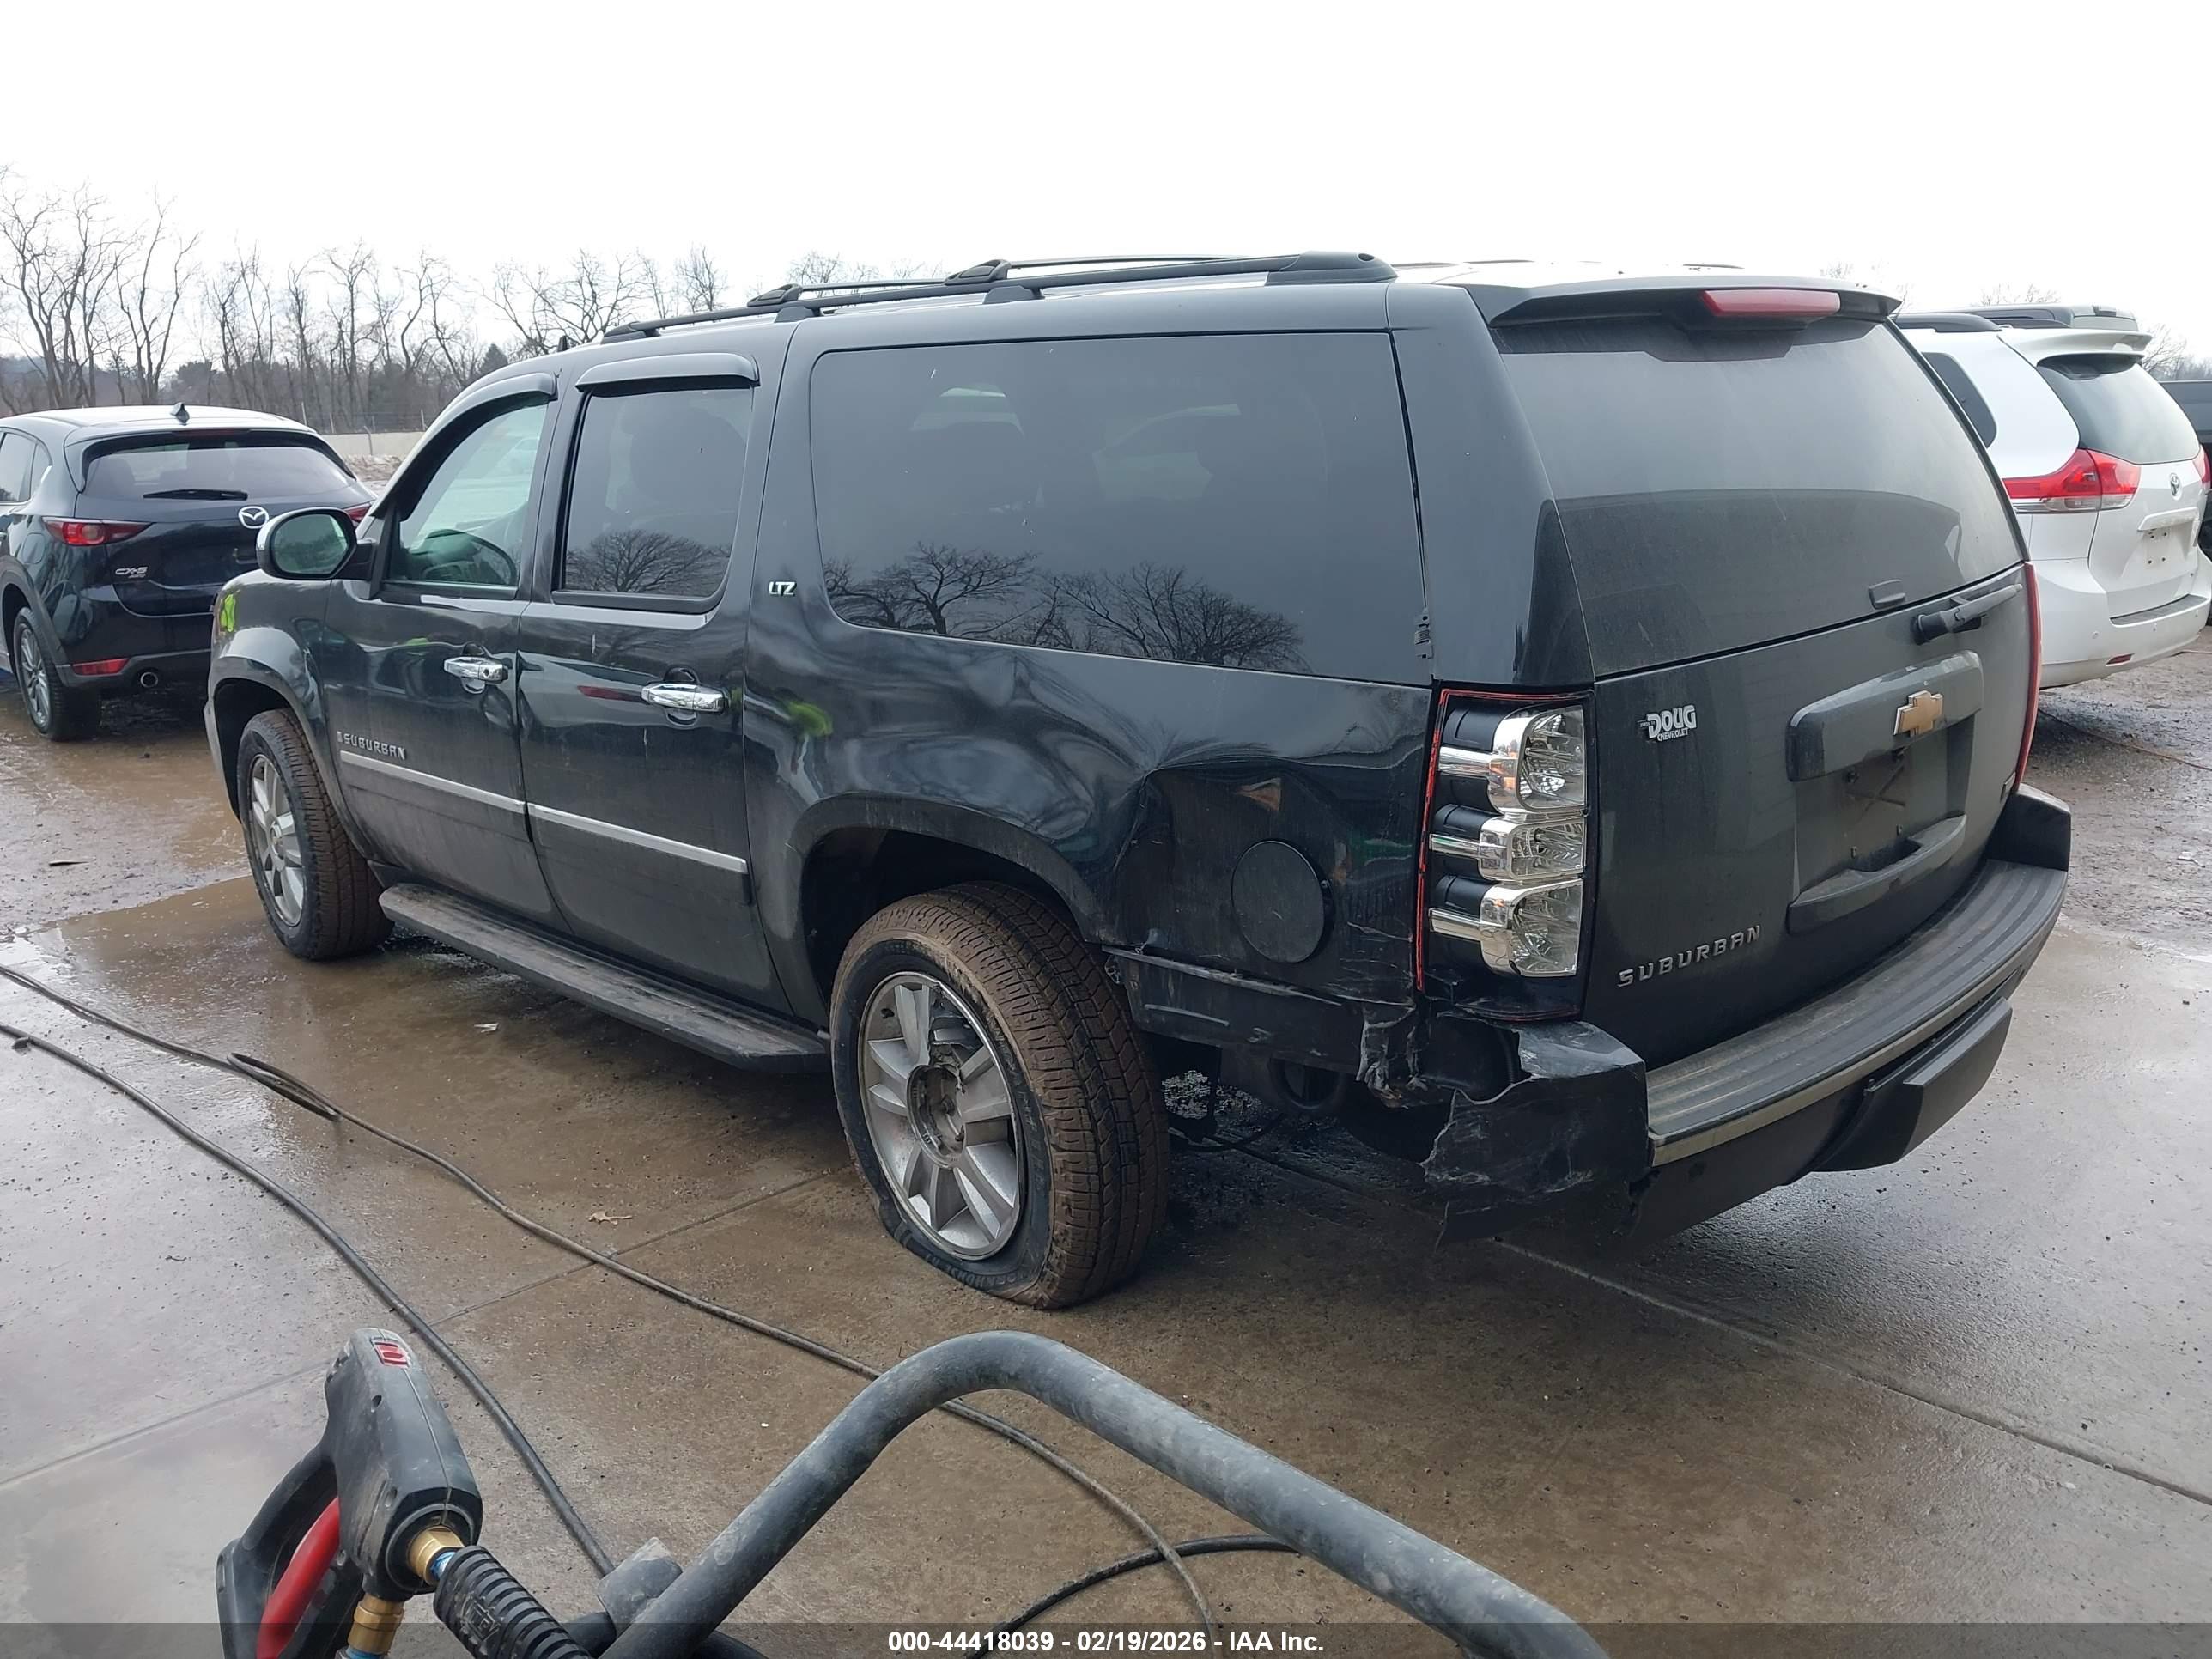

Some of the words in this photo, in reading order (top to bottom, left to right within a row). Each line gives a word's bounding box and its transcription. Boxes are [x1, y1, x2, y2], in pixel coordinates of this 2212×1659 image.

[769, 581, 796, 595] LTZ
[1647, 704, 1697, 738] DOUG
[1657, 727, 1689, 742] CHEVROLET
[343, 733, 405, 760] SUBURBAN
[1618, 925, 1760, 988] SUBURBAN
